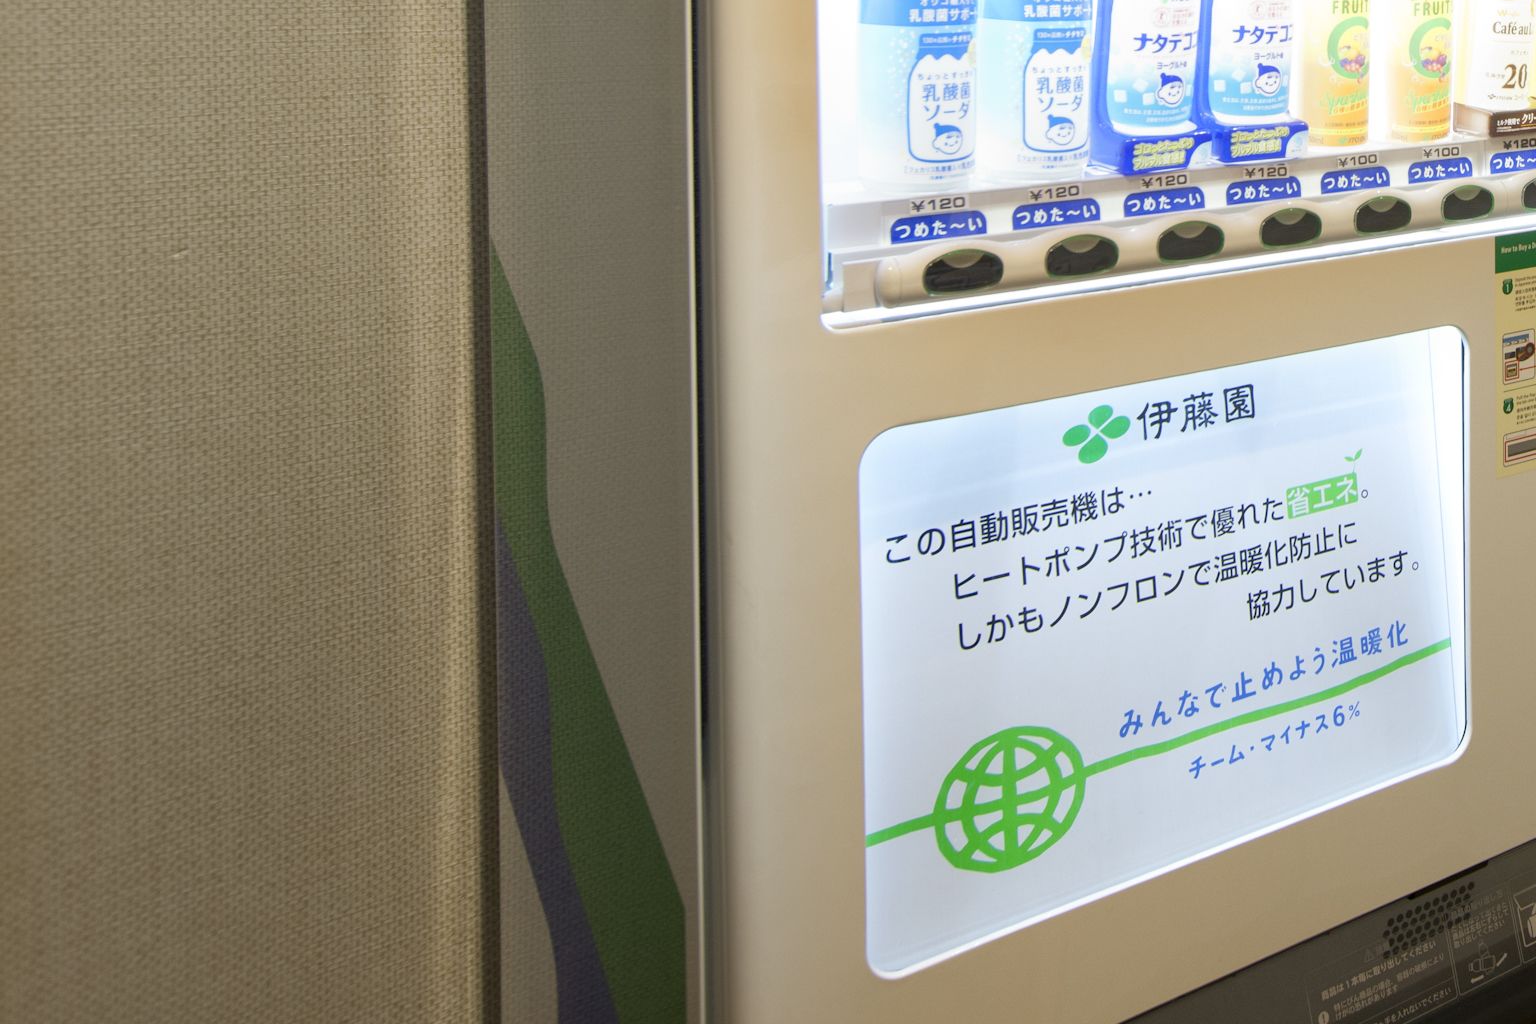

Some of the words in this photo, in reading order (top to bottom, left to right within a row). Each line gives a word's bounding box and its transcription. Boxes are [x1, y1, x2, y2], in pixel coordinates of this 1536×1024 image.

[922, 82, 971, 102] 乳酸菌
[1036, 76, 1084, 94] 乳酸菌
[924, 99, 970, 121] ソーダ
[1038, 94, 1083, 112] ソーダ
[1338, 154, 1378, 167] ¥100
[1423, 146, 1460, 159] ¥100
[1141, 174, 1188, 188] ¥120
[1244, 166, 1288, 178] ¥120
[1029, 185, 1080, 201] ¥120
[911, 195, 966, 212] ¥120
[1518, 243, 1527, 254] Buy
[1136, 384, 1256, 442] 伊藤園
[957, 521, 1358, 651] しかもノンフロンで温暖化防止に
[1247, 549, 1420, 621] 協力しています。
[1118, 621, 1409, 740] みんなで止めよう温暖化
